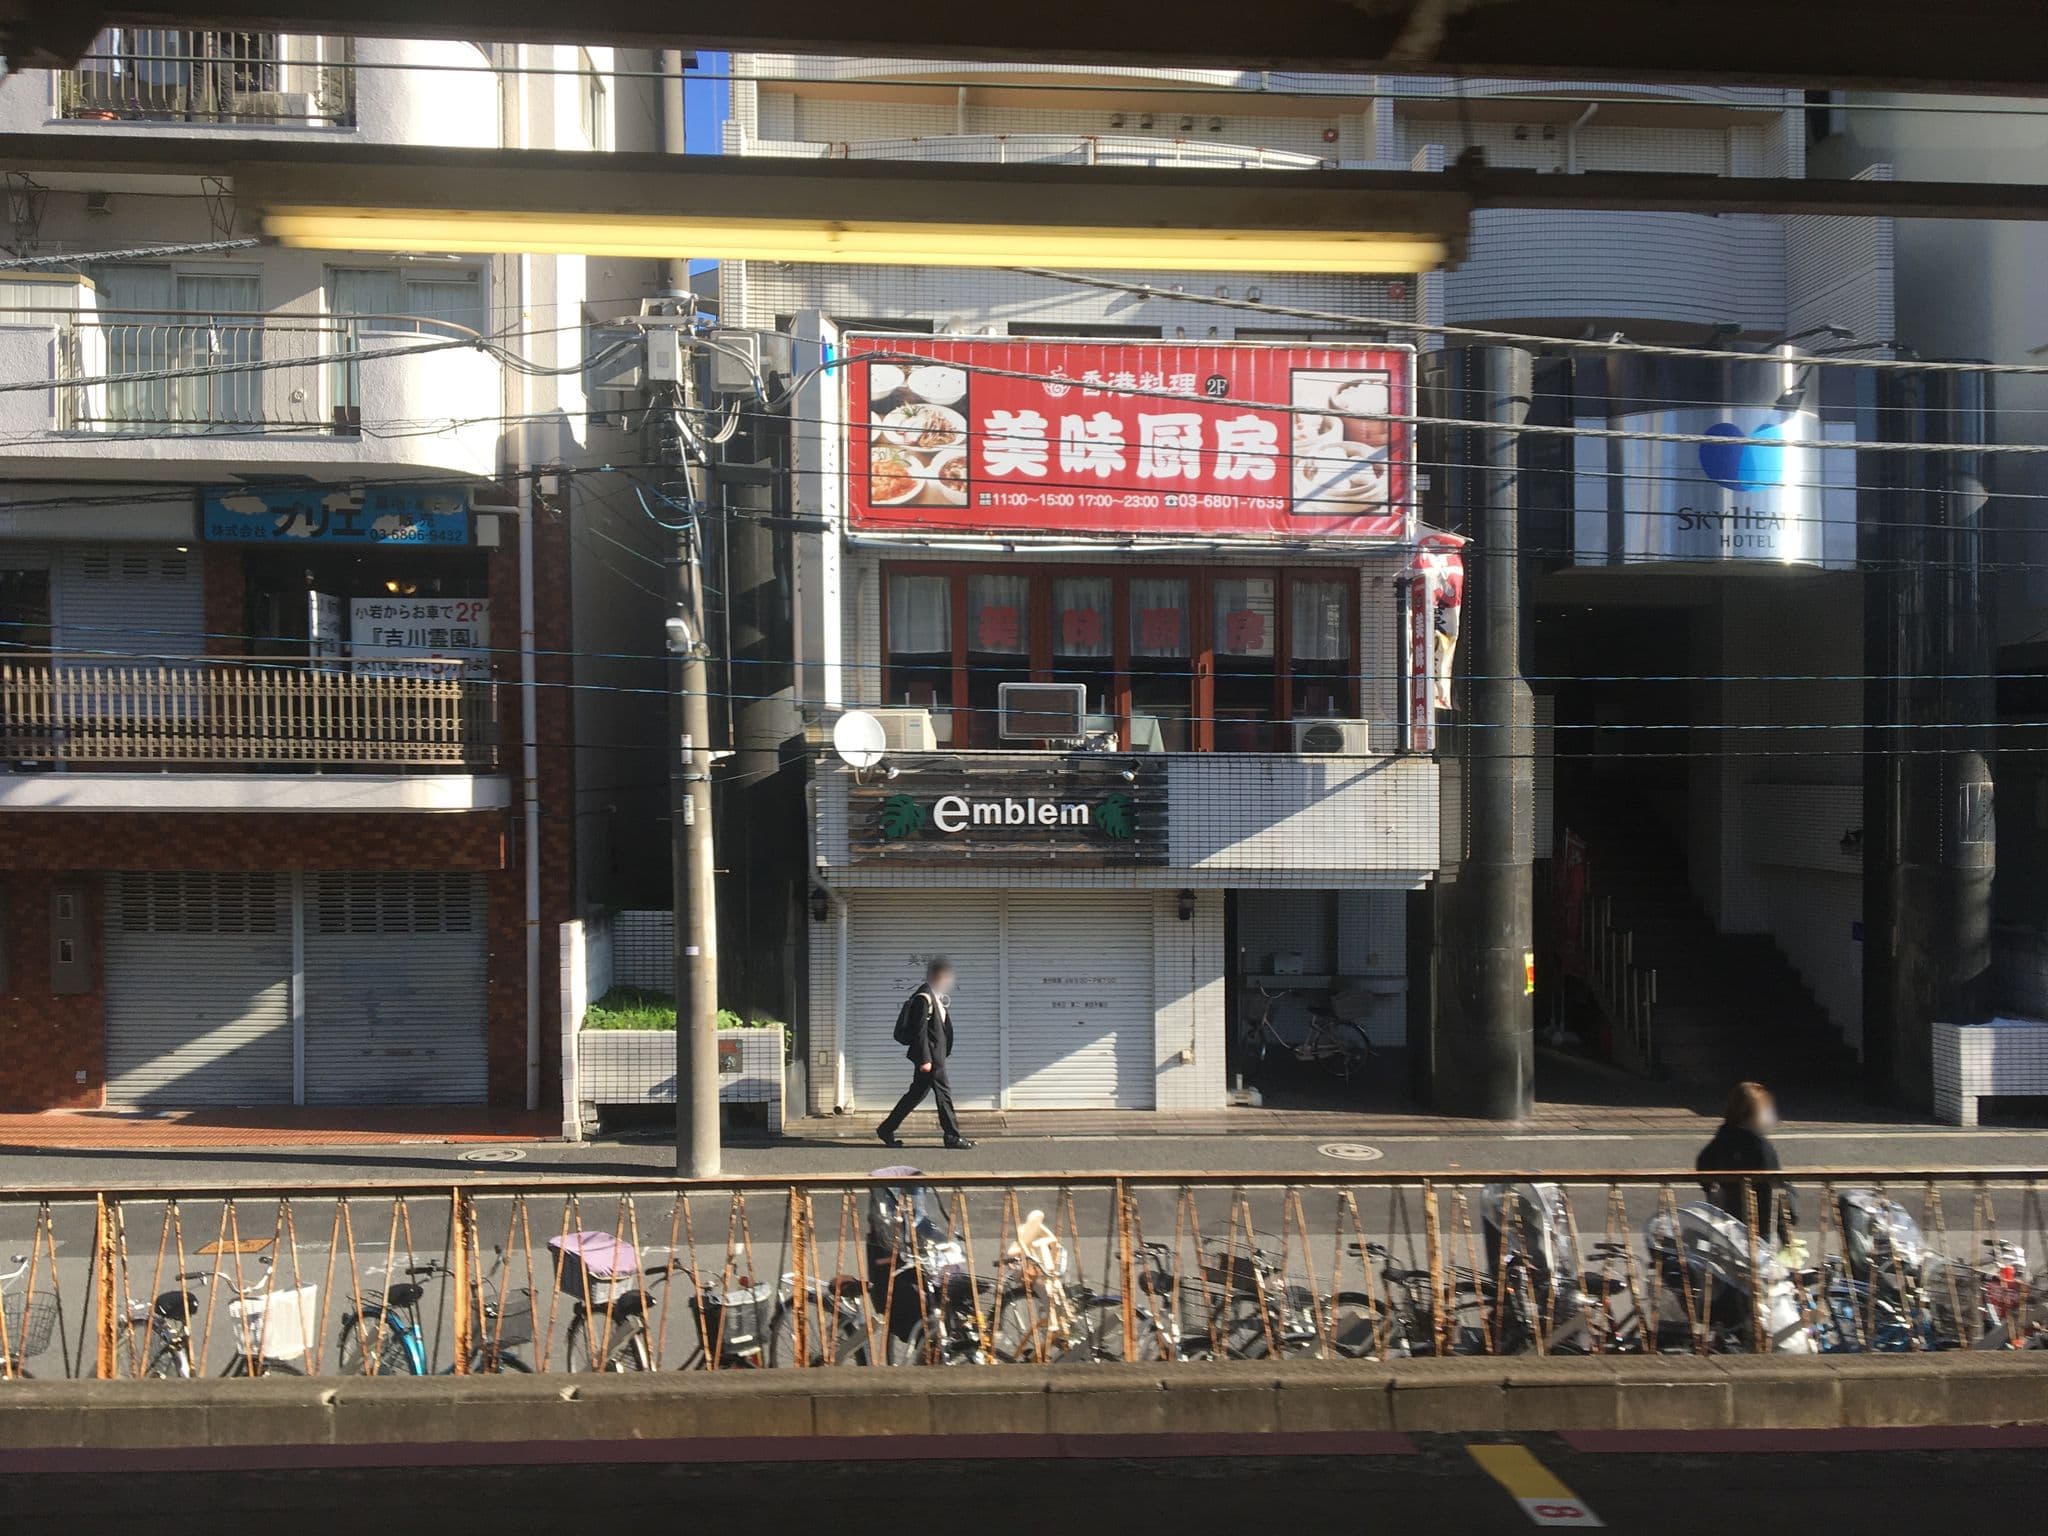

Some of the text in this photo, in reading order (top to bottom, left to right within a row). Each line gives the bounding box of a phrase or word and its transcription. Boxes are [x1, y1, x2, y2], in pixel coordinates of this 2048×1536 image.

[1082, 370, 1199, 398] 香港料理
[983, 410, 1279, 481] 美味厨房
[1720, 534, 1776, 548] HOTEL
[933, 795, 1089, 832] emblem
